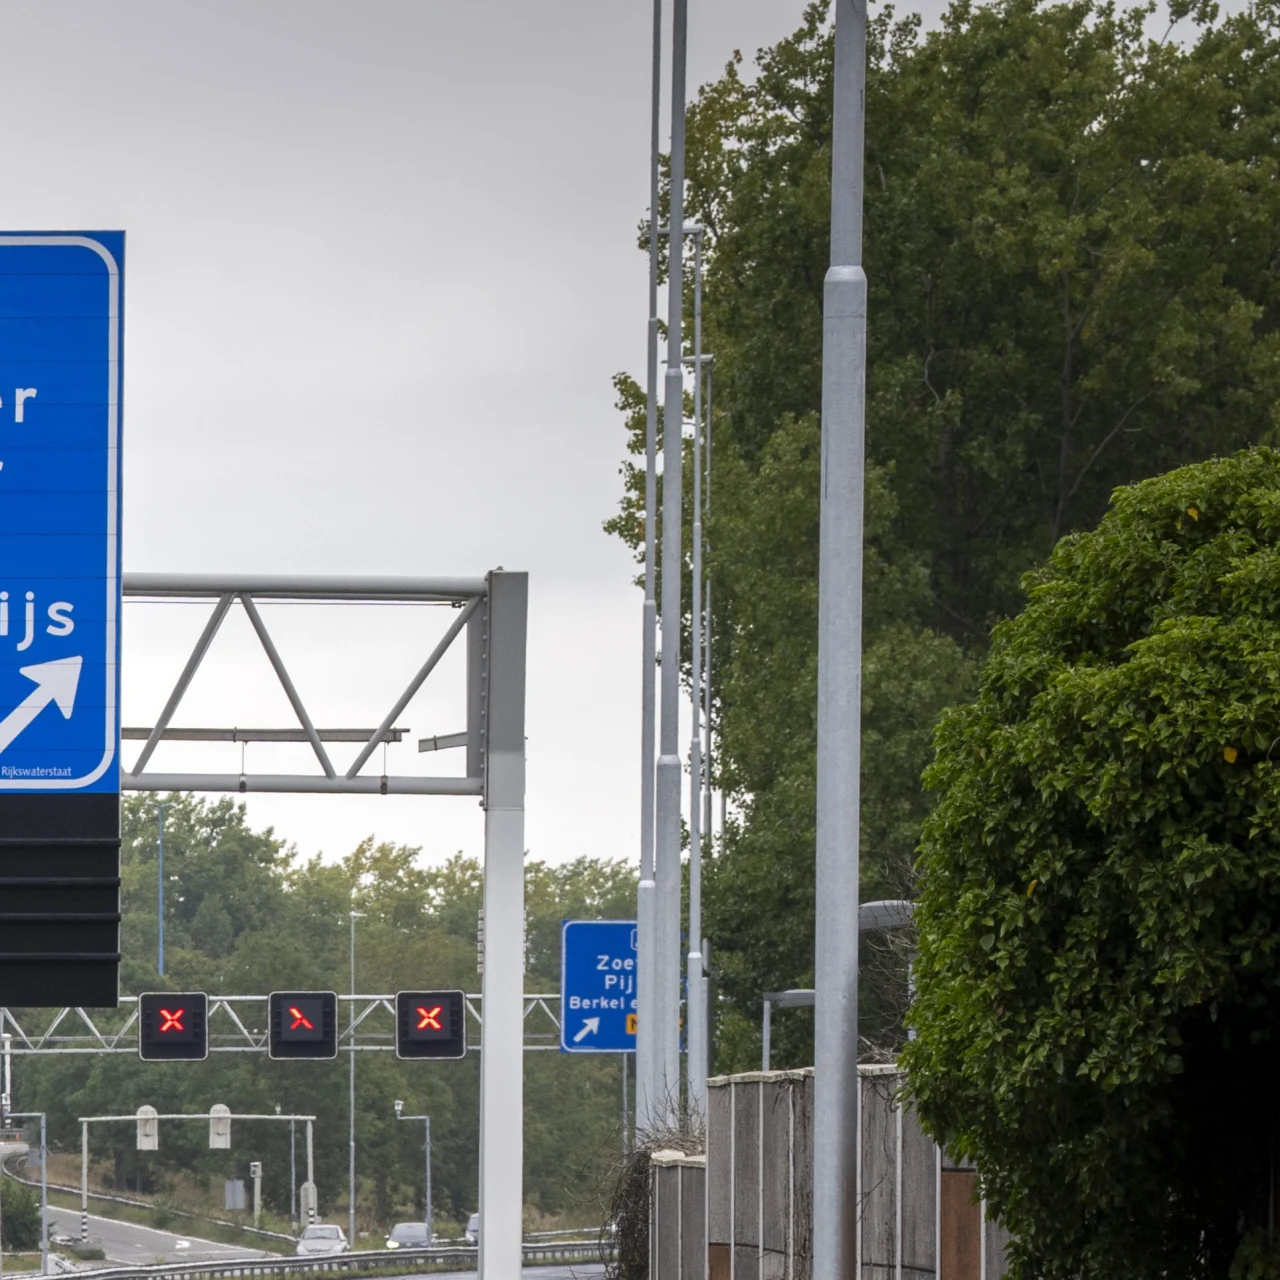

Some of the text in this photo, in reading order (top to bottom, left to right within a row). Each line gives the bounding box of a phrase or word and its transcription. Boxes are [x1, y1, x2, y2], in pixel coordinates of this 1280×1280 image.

[1, 765, 72, 779] Rijkswaterstaat
[596, 955, 638, 970] Zoe
[604, 975, 633, 994] Pij
[569, 996, 625, 1010] Berkel
